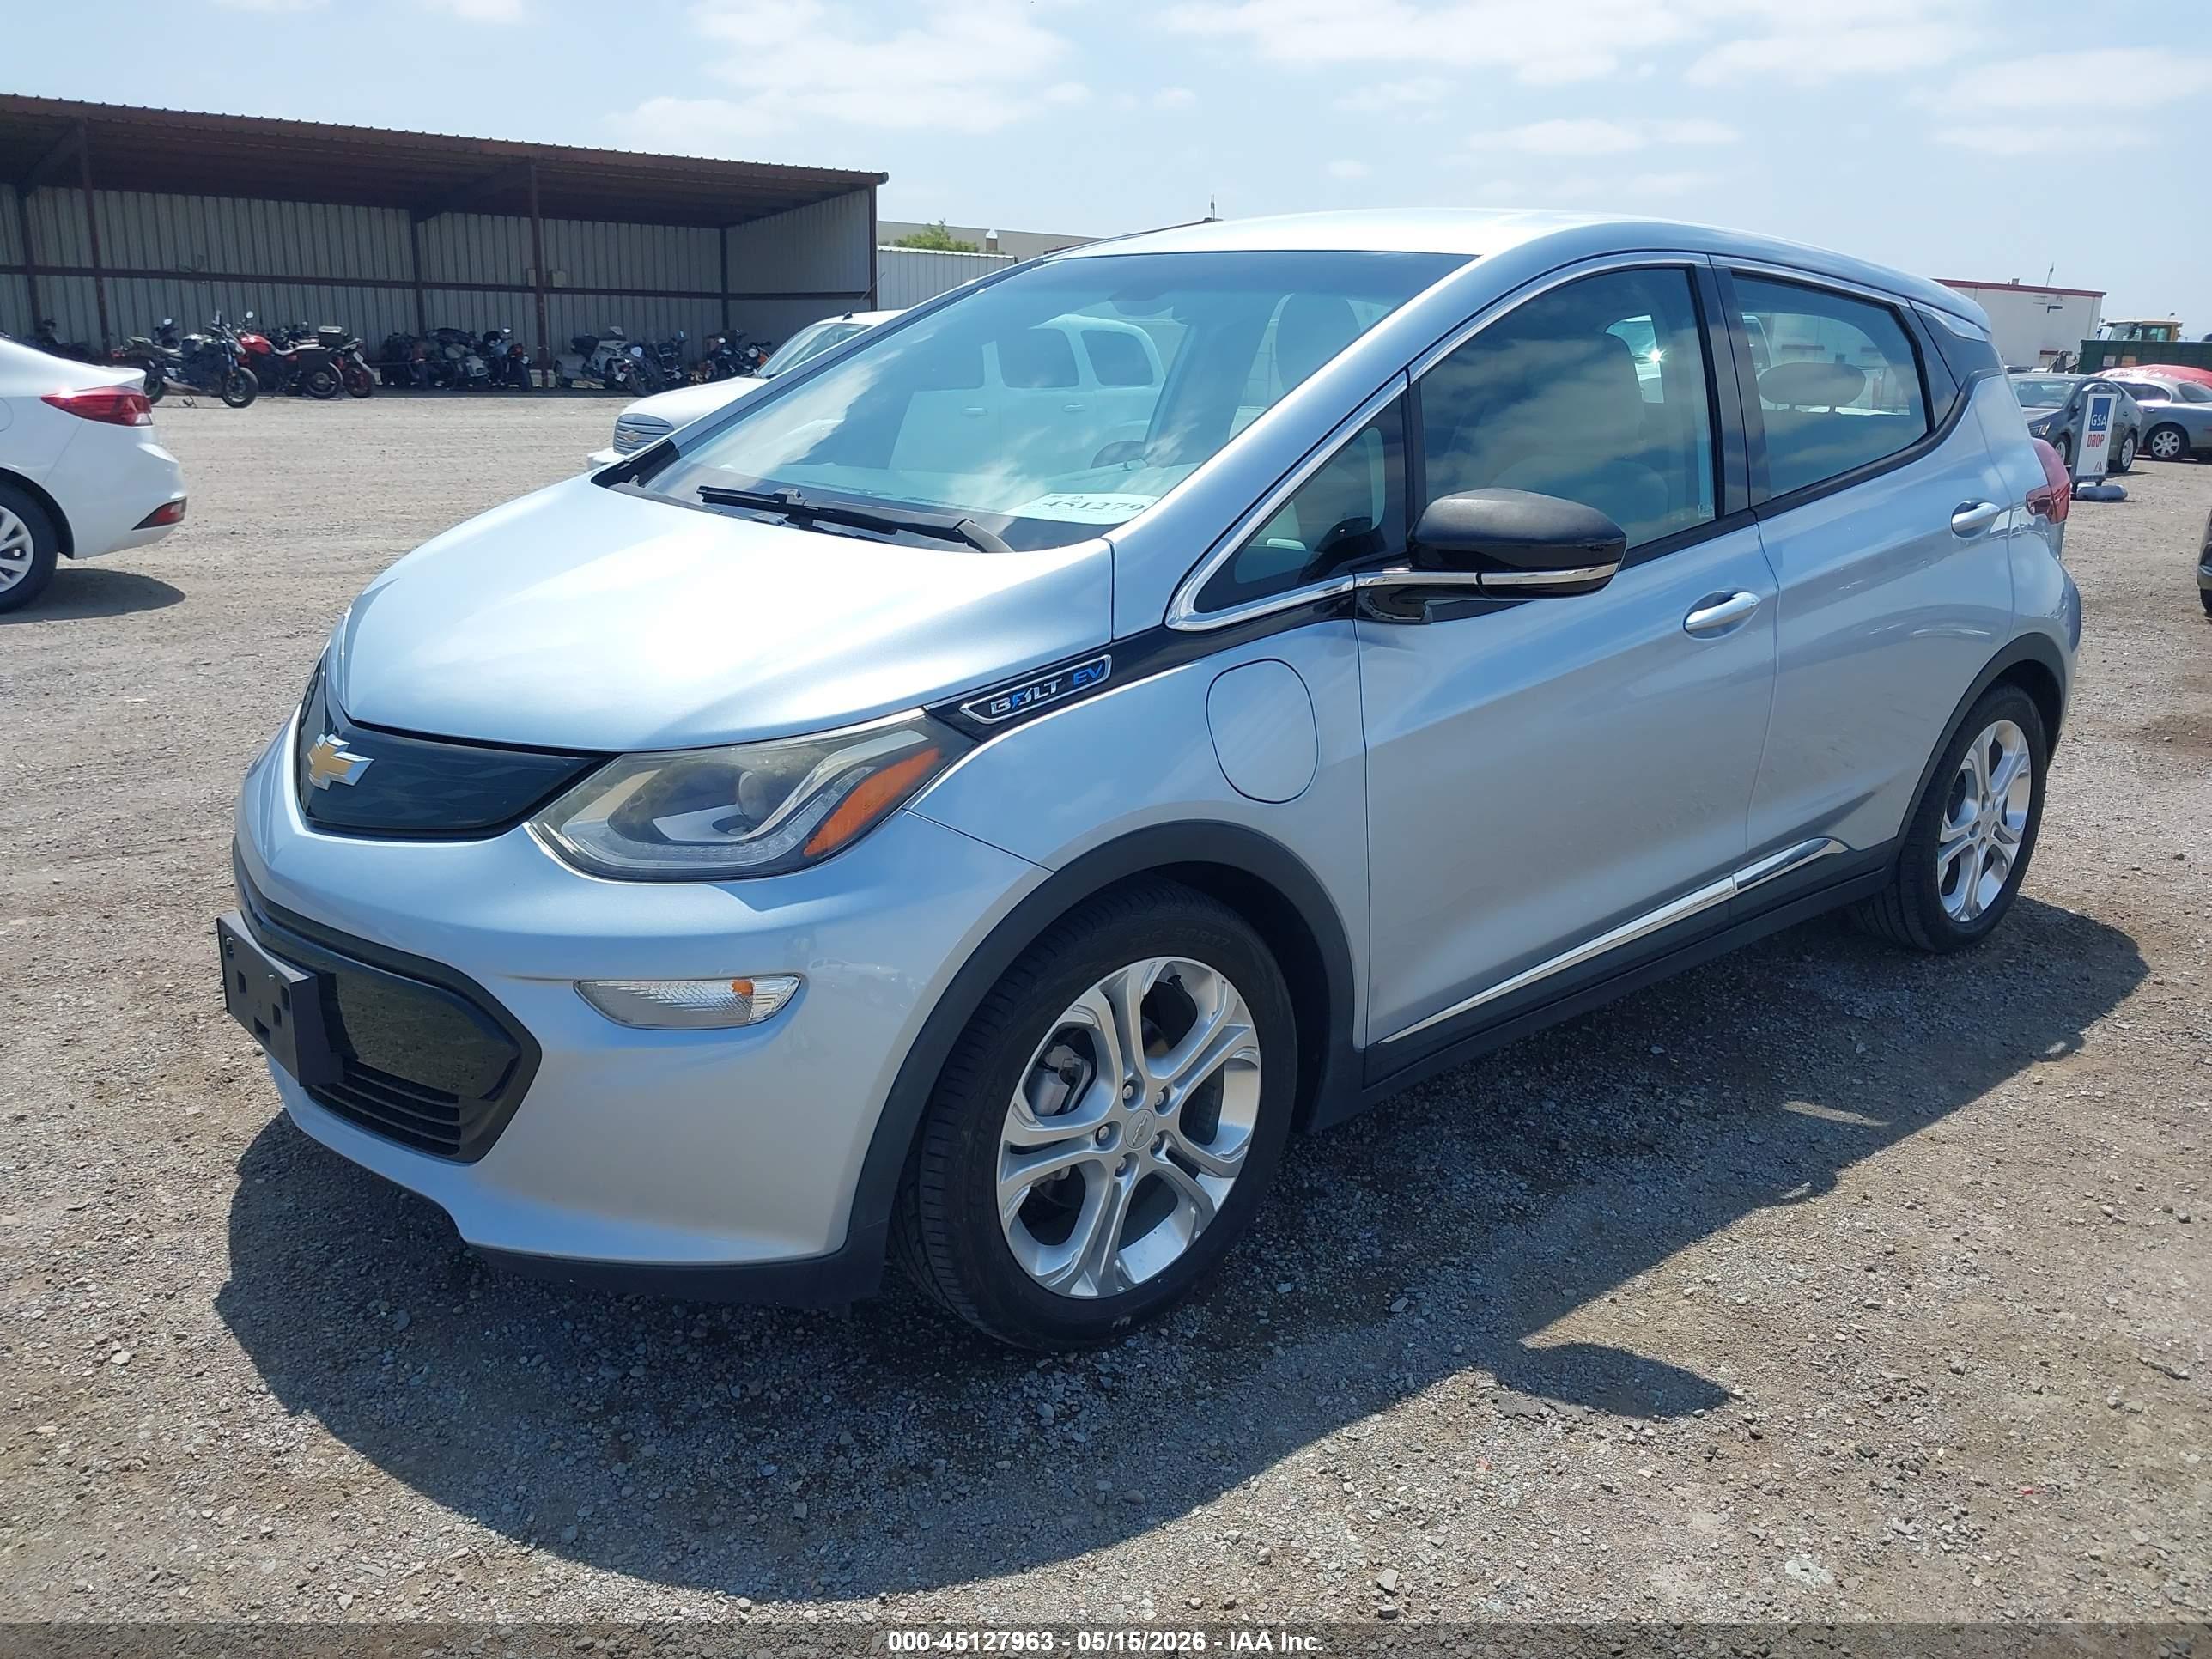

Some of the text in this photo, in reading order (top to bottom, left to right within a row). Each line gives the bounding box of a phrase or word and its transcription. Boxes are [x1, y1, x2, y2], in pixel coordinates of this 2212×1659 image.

[2091, 414, 2106, 426] GSA
[2087, 434, 2105, 447] DROP
[1042, 501, 1146, 511] 451279
[990, 662, 1104, 714] BOLT EV
